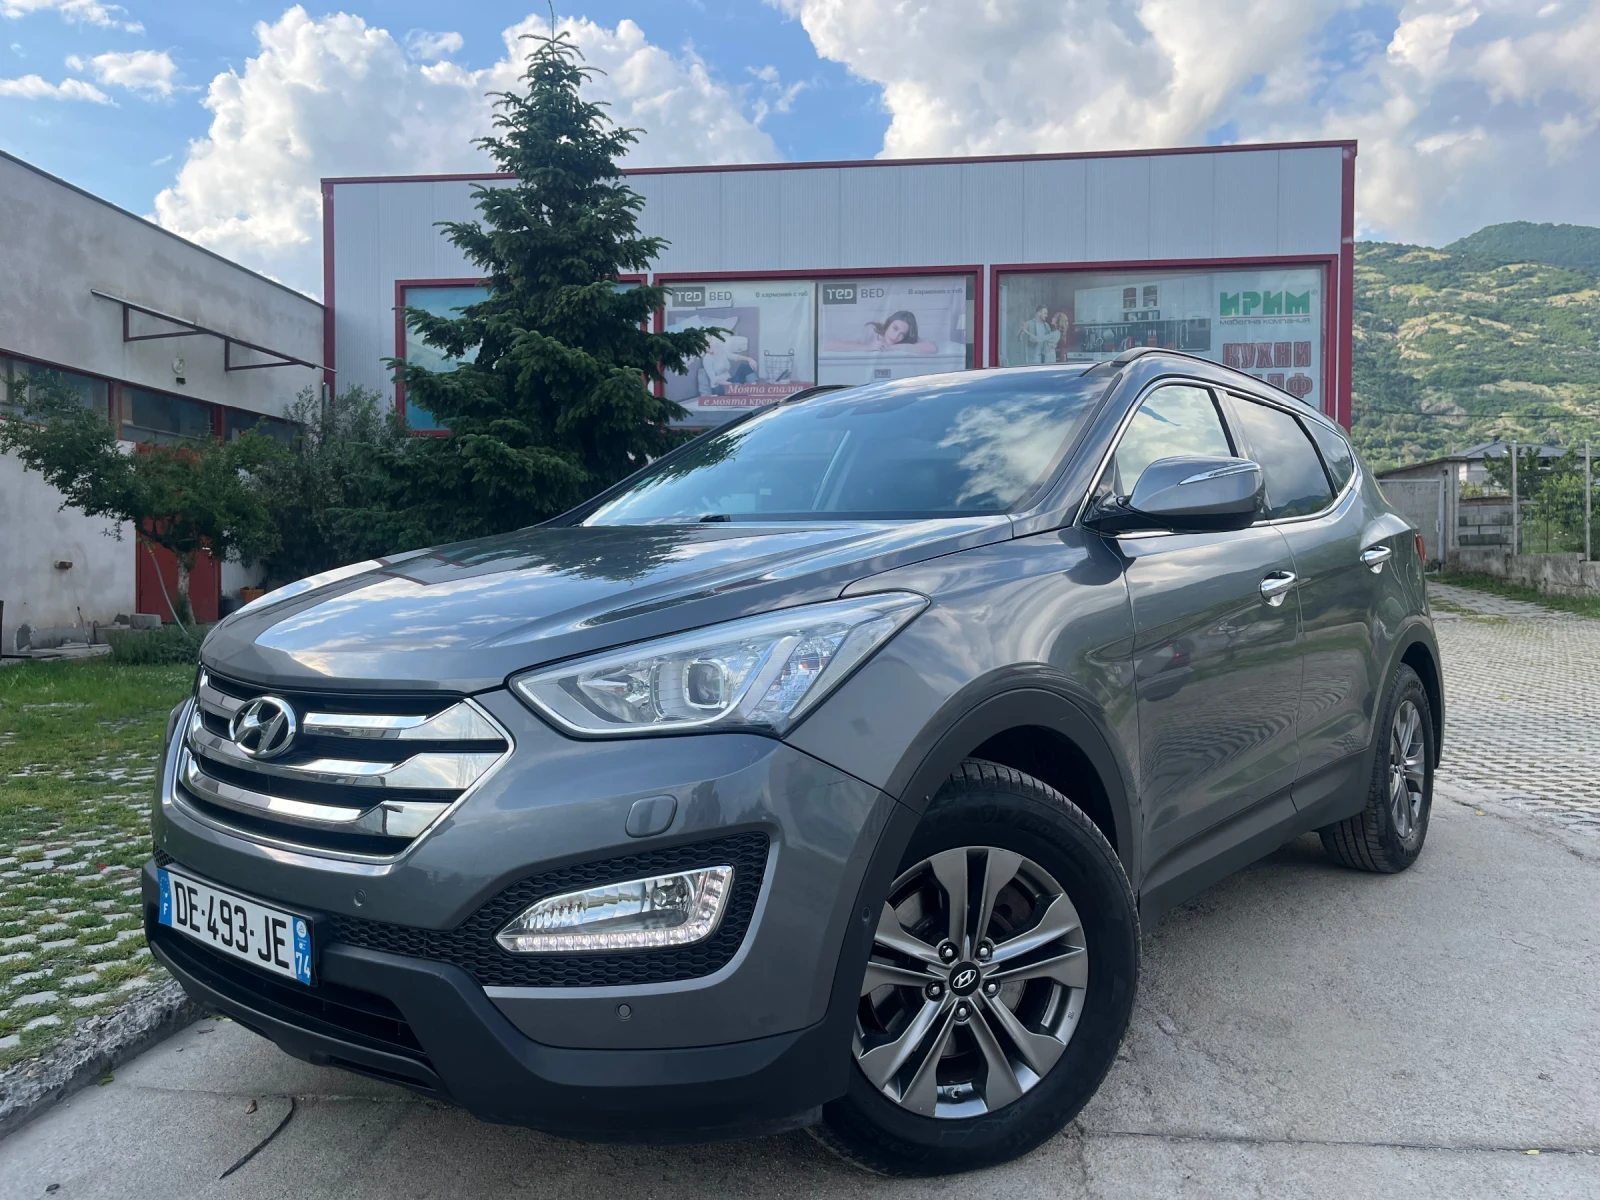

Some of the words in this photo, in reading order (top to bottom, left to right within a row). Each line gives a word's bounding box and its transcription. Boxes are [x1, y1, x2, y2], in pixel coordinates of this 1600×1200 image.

[709, 291, 733, 301] BED
[761, 291, 792, 299] хармония
[861, 288, 885, 299] BED
[1220, 289, 1310, 316] ИРИМ
[1223, 341, 1311, 369] КУХНИ
[728, 384, 765, 394] Моята
[767, 385, 804, 394] спалня
[163, 903, 169, 915] F
[174, 880, 290, 970] DE-493-JE
[295, 951, 310, 978] 74
